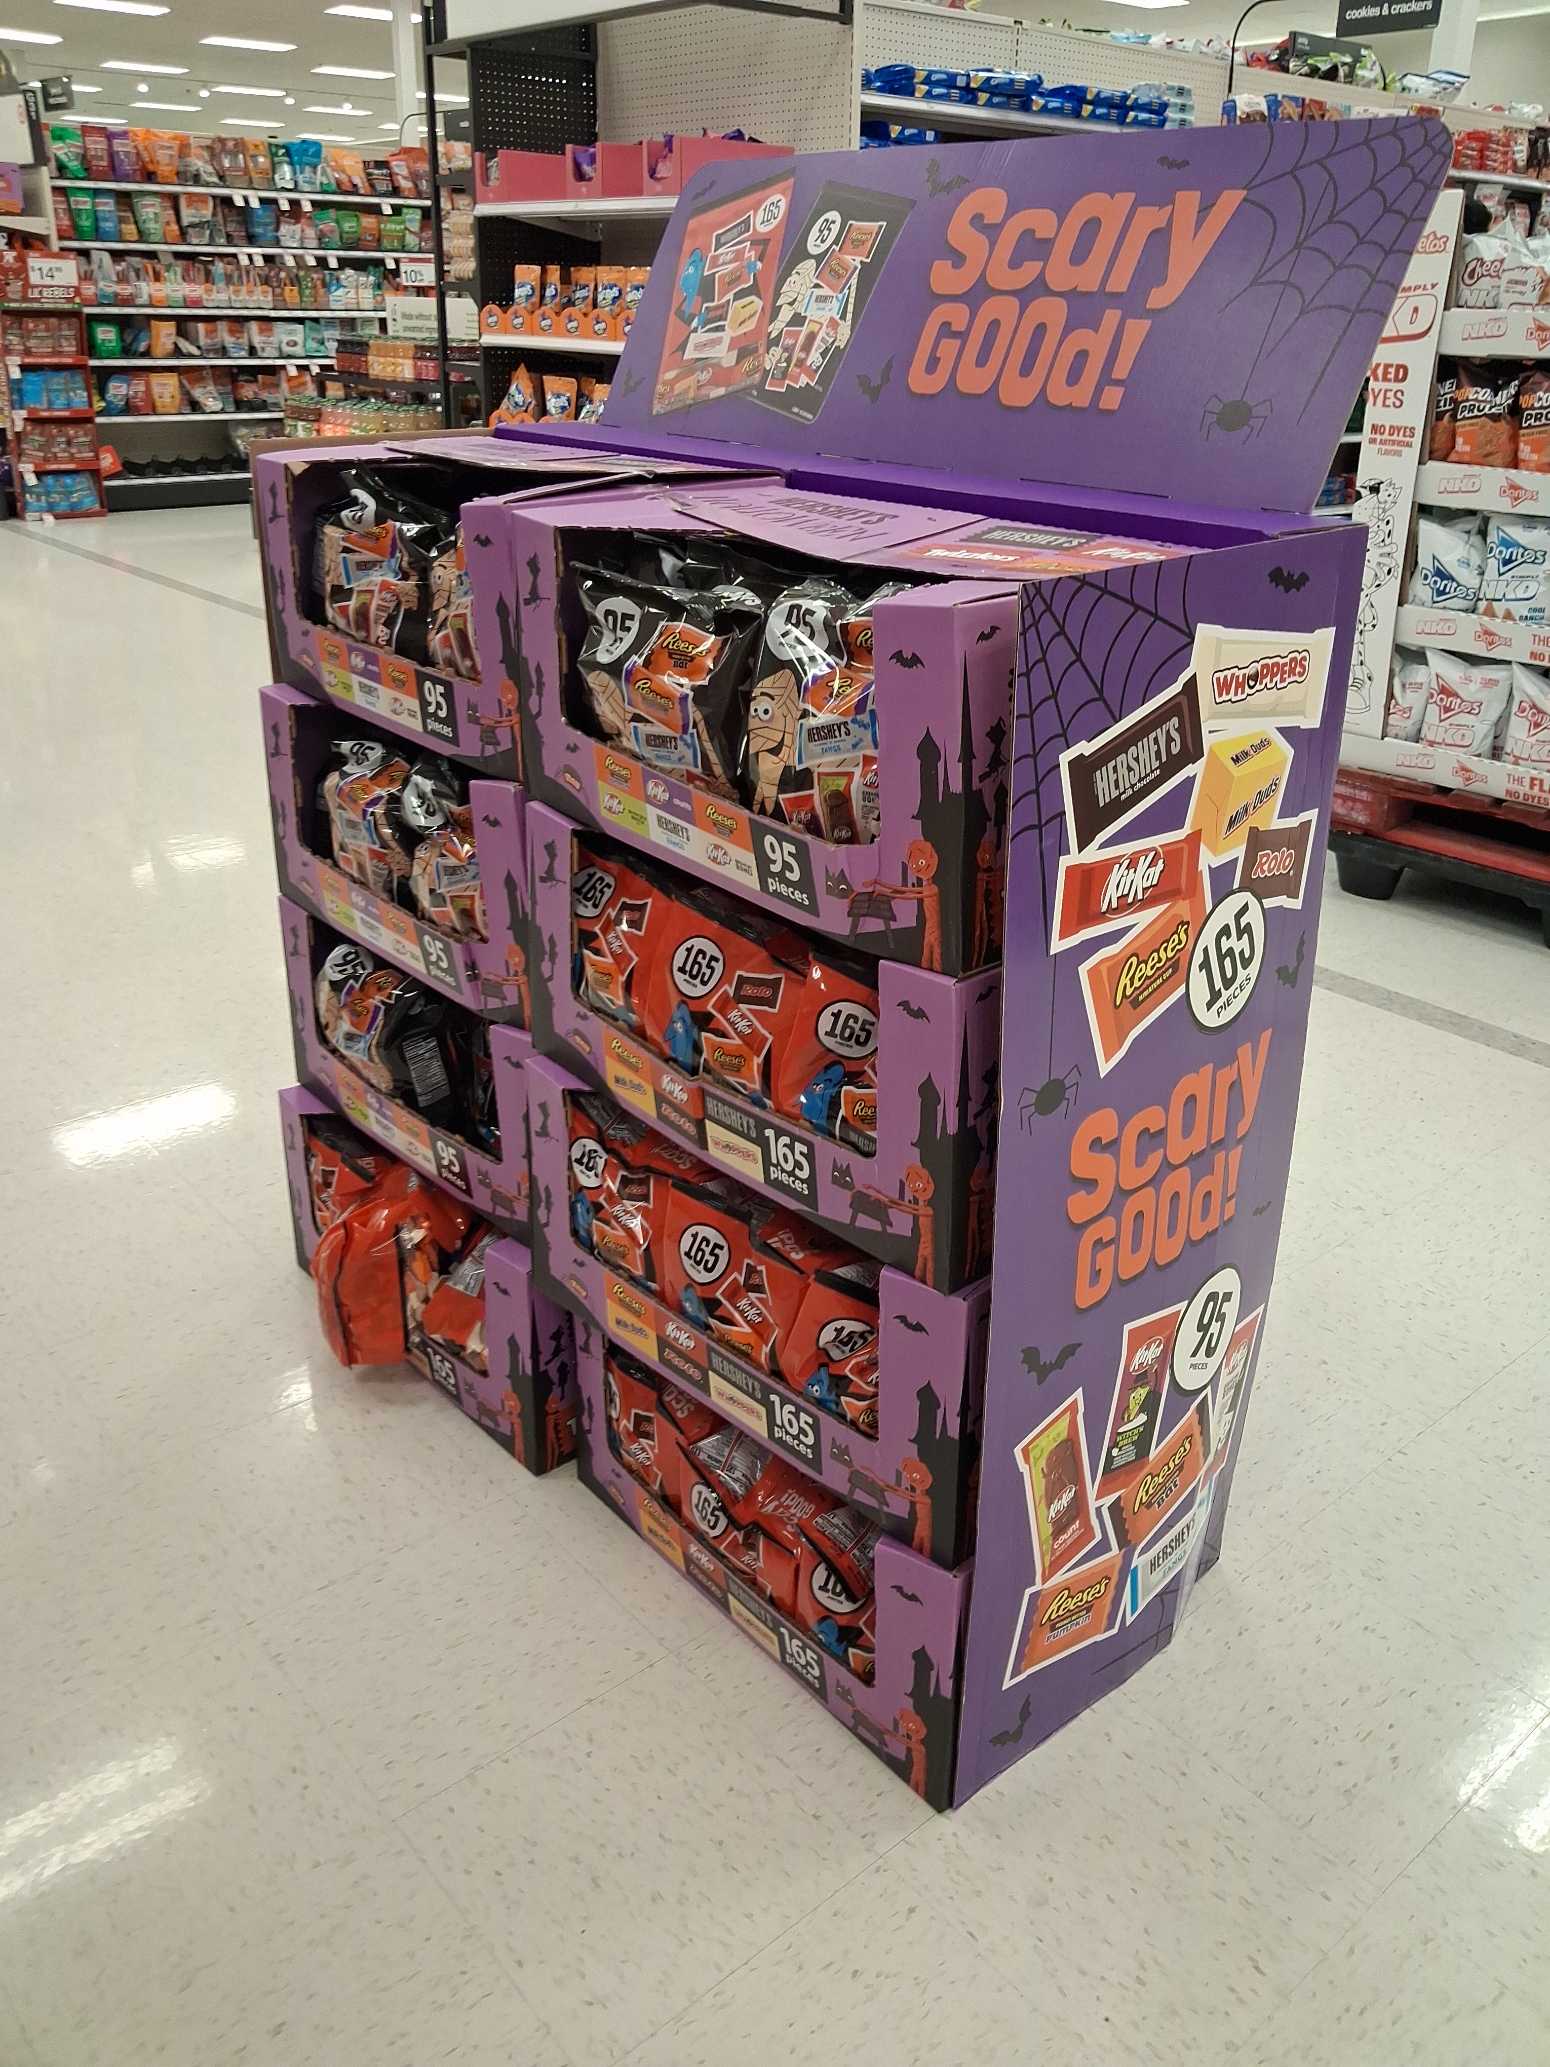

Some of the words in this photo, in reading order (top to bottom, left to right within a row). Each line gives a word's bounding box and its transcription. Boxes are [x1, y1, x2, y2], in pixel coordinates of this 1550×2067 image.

[1346, 7, 1380, 20] cookies
[1381, 3, 1389, 15] &
[1391, 0, 1432, 14] crackers
[760, 199, 782, 226] 165
[814, 218, 836, 244] 95
[1370, 423, 1387, 437] NO
[1388, 424, 1416, 439] DYES
[982, 529, 1087, 548] HERSHEY'S
[1488, 541, 1547, 565] Doritos
[1421, 567, 1478, 600] Doritos
[1213, 651, 1309, 703] WHOPPERS
[423, 680, 448, 718] 95
[1428, 687, 1483, 715] Doritos
[807, 720, 851, 743] HERSHEY'S
[1094, 716, 1181, 808] HERSHEY'S
[1230, 748, 1250, 767] Milk
[1250, 736, 1272, 757] Duds
[1505, 788, 1520, 800] NO
[1507, 773, 1526, 786] THE
[705, 803, 738, 830] Reese's
[1224, 799, 1249, 836] Milk
[1250, 776, 1280, 814] Duds
[763, 834, 801, 882] 95
[1251, 846, 1295, 880] Rolo
[575, 869, 612, 909] 165
[767, 877, 810, 905] pieces
[1101, 850, 1165, 914] KitKat
[423, 934, 449, 969] 95
[677, 944, 721, 987] 165
[1114, 921, 1190, 1008] Reese's
[1197, 901, 1256, 1012] 165
[1216, 974, 1252, 1018] PIECES
[824, 1009, 876, 1046] 165
[713, 1047, 746, 1066] Reese's
[705, 1096, 757, 1138] HERSHEY'S
[436, 1140, 462, 1173] 95
[764, 1128, 810, 1179] 165
[769, 1165, 809, 1195] pieces
[683, 1230, 724, 1274] 165
[1190, 1291, 1233, 1358] 95
[1188, 1363, 1208, 1371] PIECES
[769, 1394, 815, 1446] 165
[774, 1425, 813, 1459] pieces
[1133, 1433, 1192, 1515] Reese's
[694, 1489, 721, 1528] 165
[1040, 1576, 1111, 1627] Reese's
[779, 1626, 821, 1677] 165
